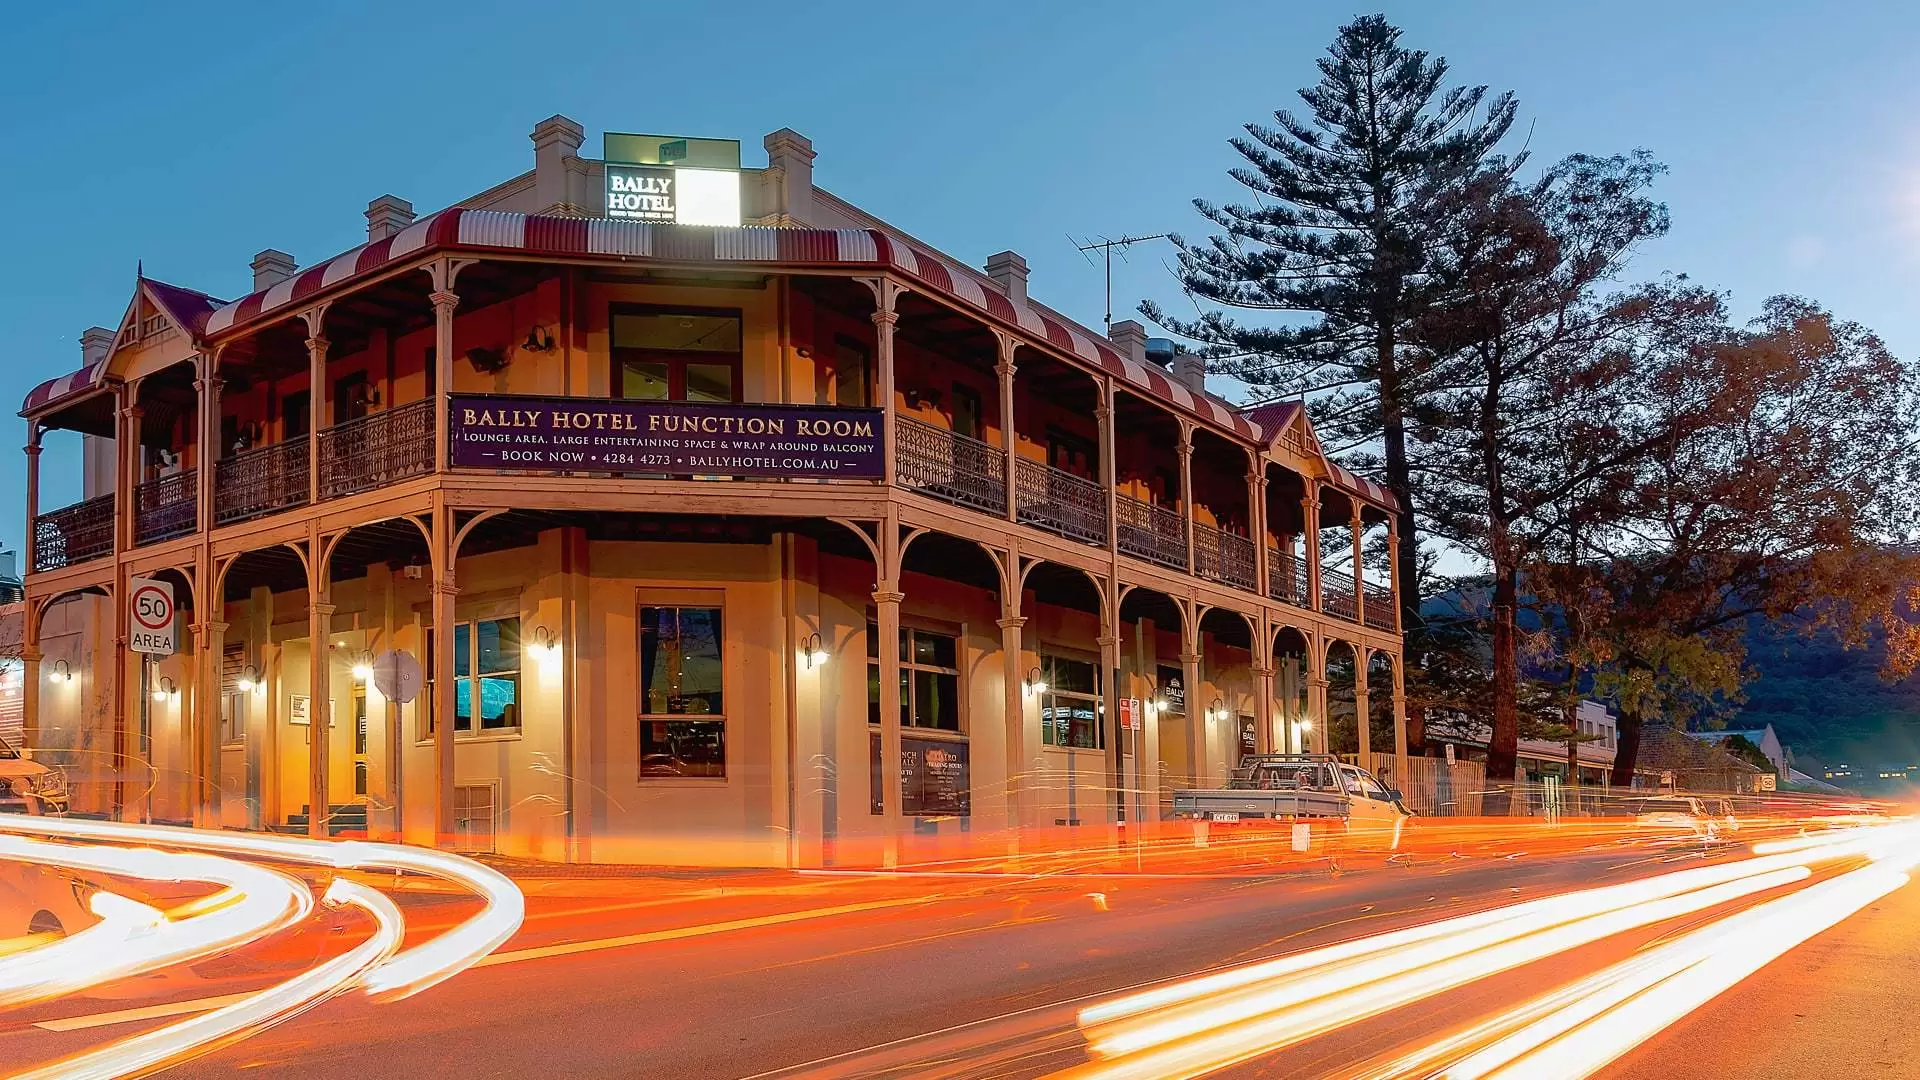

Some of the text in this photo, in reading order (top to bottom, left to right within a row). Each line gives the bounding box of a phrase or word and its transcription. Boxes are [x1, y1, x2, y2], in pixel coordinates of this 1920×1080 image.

[611, 175, 672, 194] BALLY
[608, 193, 675, 213] HOTEL
[463, 408, 874, 437] BALLY HOTEL FUNCTION ROOM
[464, 433, 511, 443] LOUNGE
[553, 436, 589, 445] LARGE
[594, 436, 679, 448] ENTERTAINING
[684, 440, 716, 449] SPACE
[720, 441, 729, 449] &
[732, 441, 766, 450] WRAP
[769, 442, 818, 452] AROUND
[823, 444, 874, 453] BALCONY
[502, 450, 839, 469] BOOK NOW 4284 4273 BALLYHOTEL.COM.AU
[139, 597, 166, 618] 50
[132, 632, 172, 650] AREA
[1165, 686, 1185, 698] BALLY
